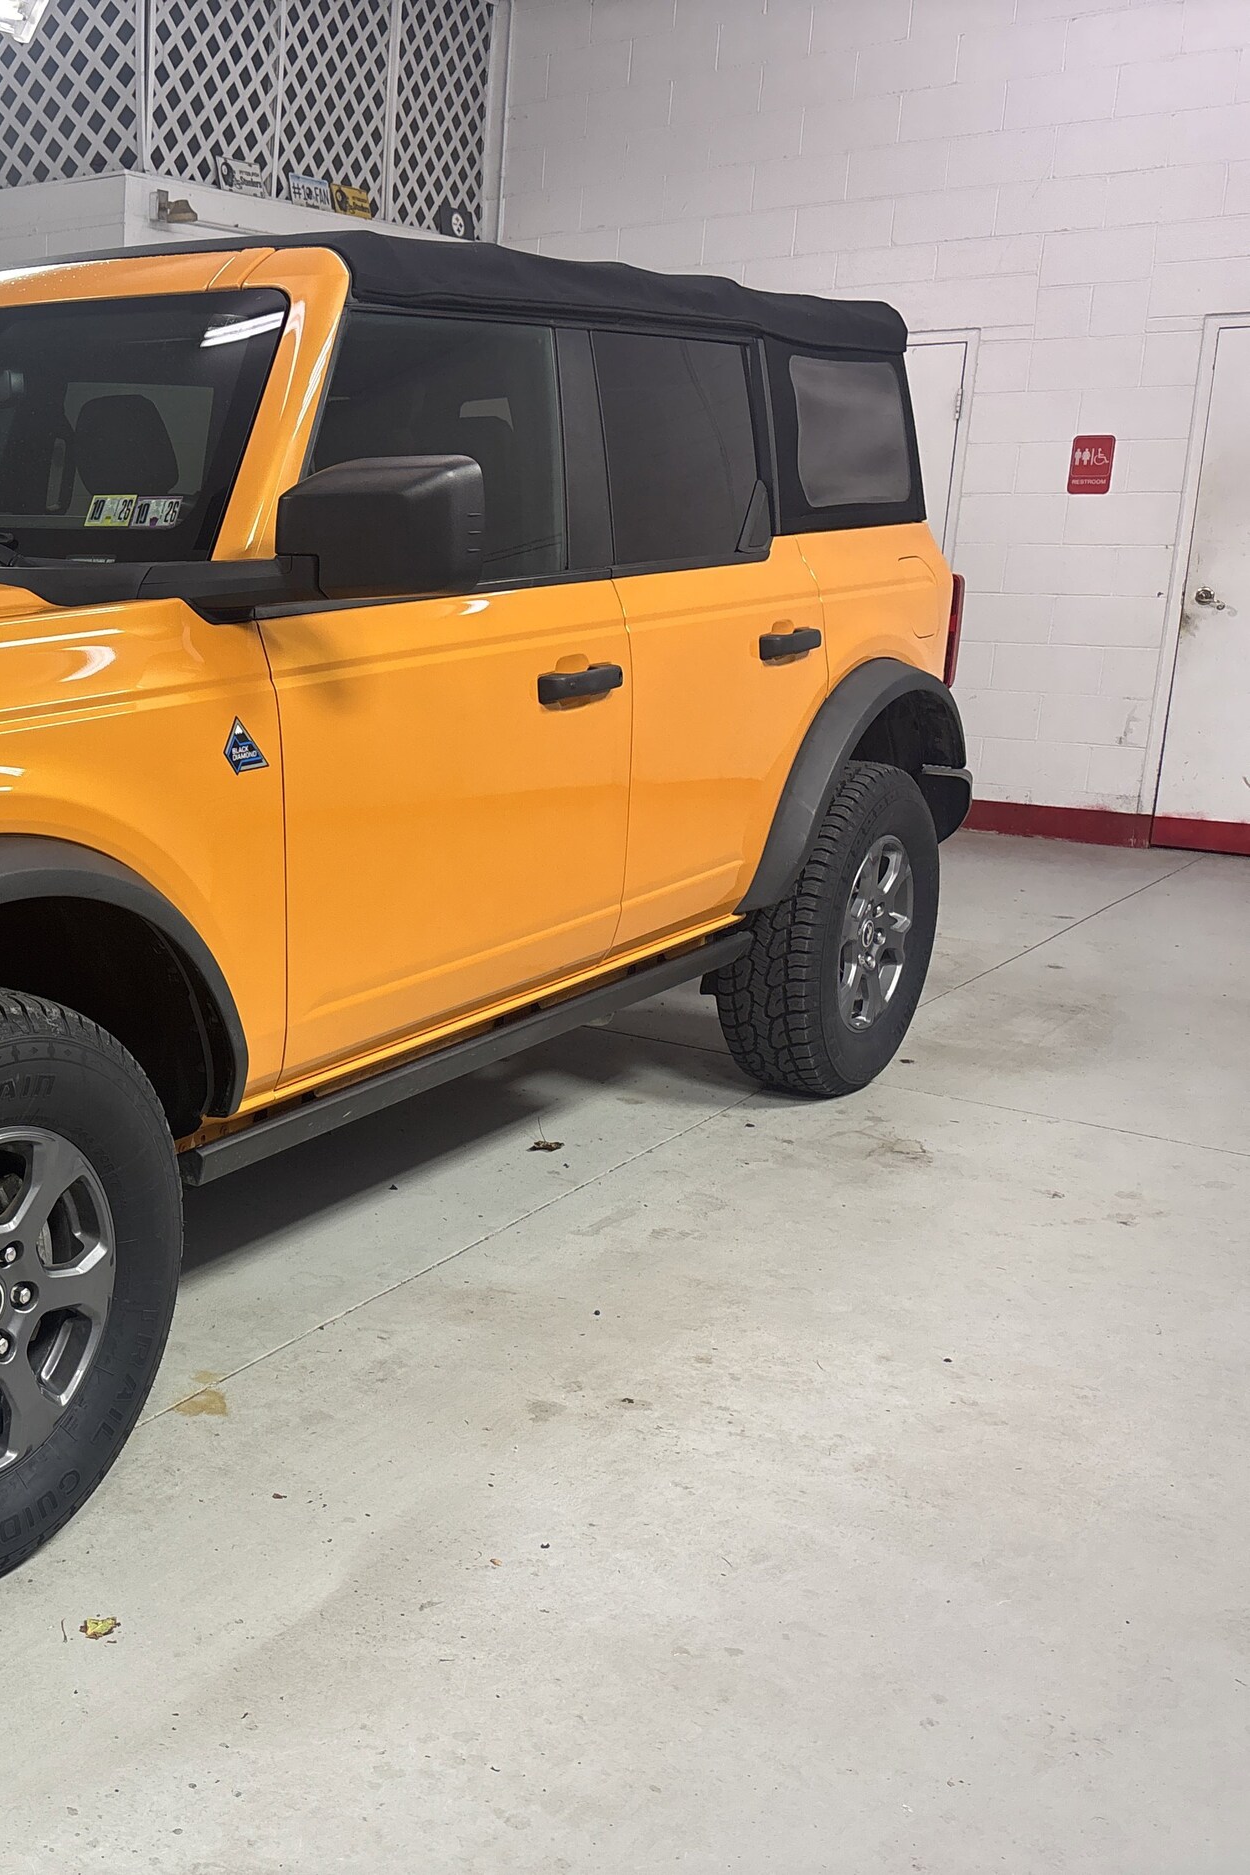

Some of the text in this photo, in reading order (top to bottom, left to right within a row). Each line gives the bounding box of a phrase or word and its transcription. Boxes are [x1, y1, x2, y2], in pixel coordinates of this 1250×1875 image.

[314, 186, 330, 205] FAN
[90, 499, 134, 521] 10 26
[135, 501, 180, 524] 10 26
[232, 746, 249, 755] BLACK
[232, 751, 257, 761] DIAMOND
